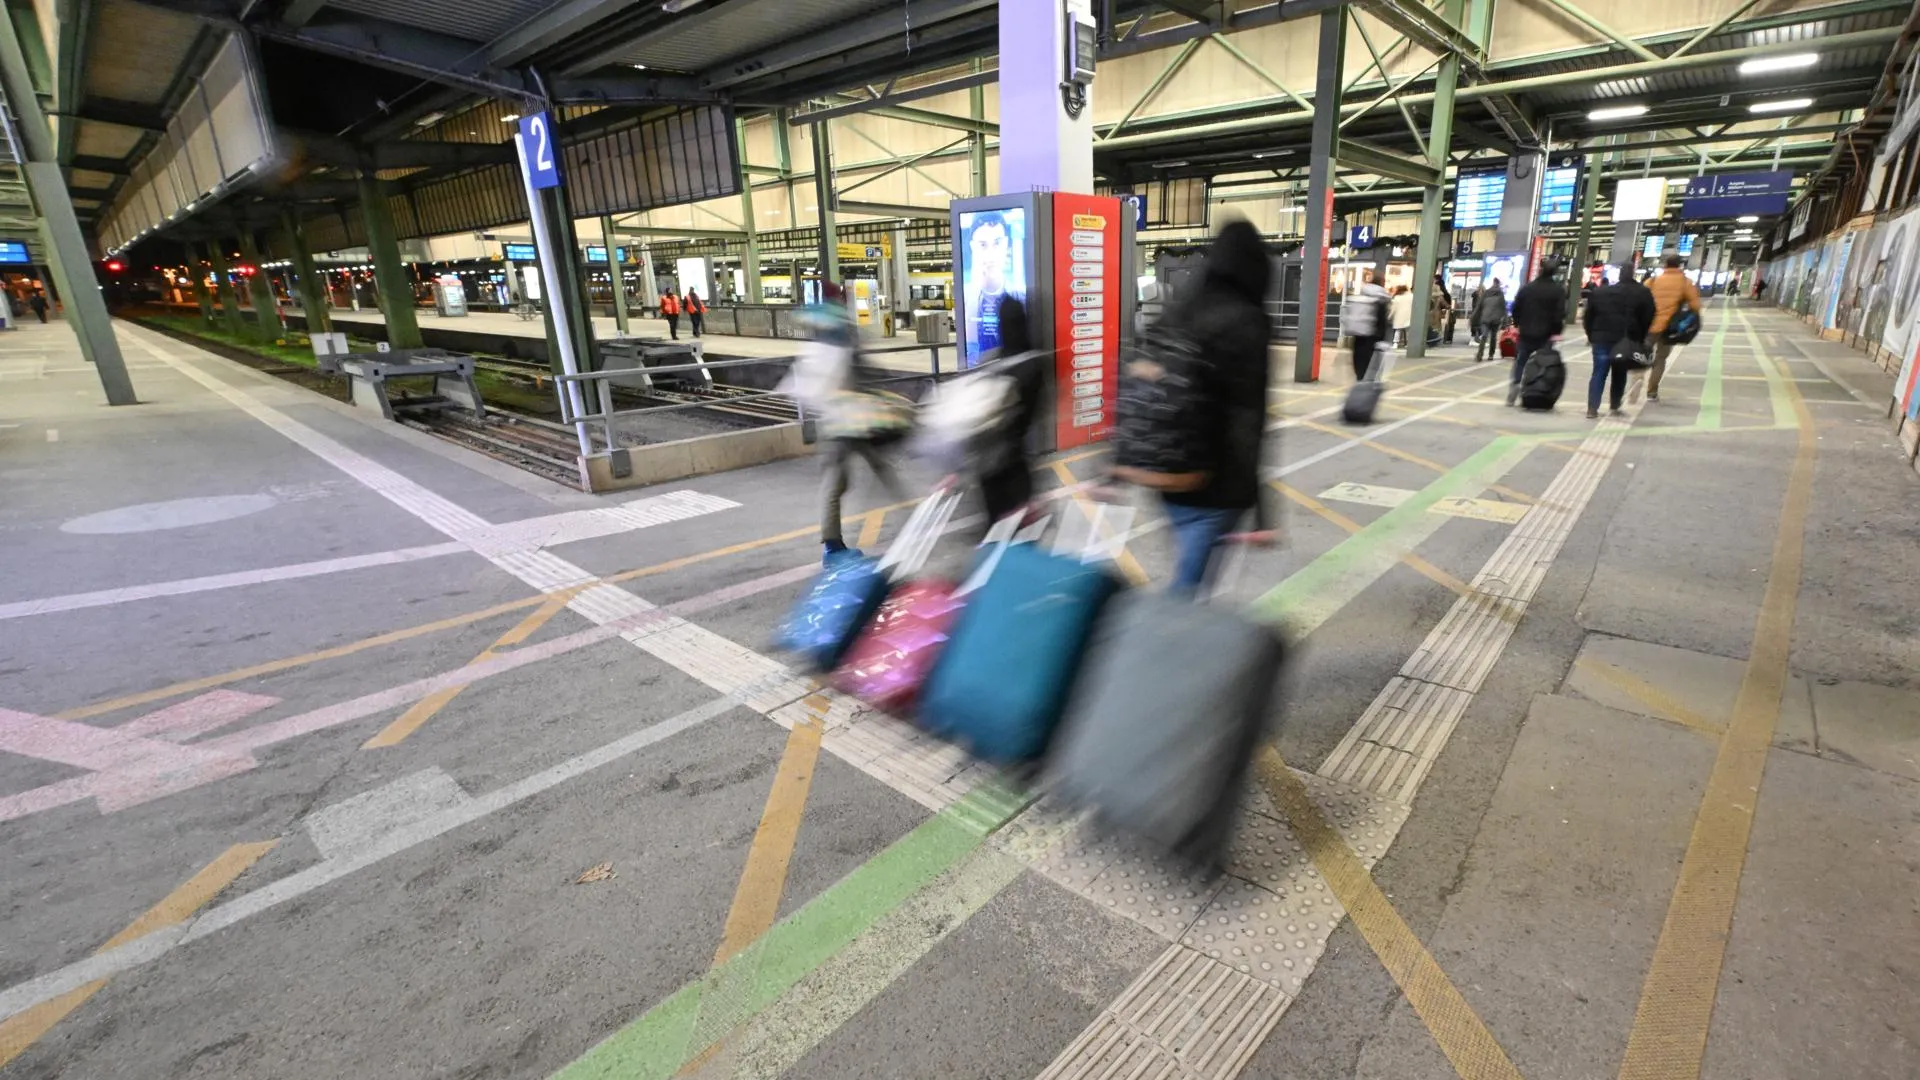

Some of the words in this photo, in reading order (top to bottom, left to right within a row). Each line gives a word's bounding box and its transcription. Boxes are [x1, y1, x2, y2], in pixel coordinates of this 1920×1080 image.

[530, 116, 552, 172] 2
[1127, 196, 1141, 222] 3
[1358, 226, 1369, 243] 4
[1463, 242, 1471, 254] 5
